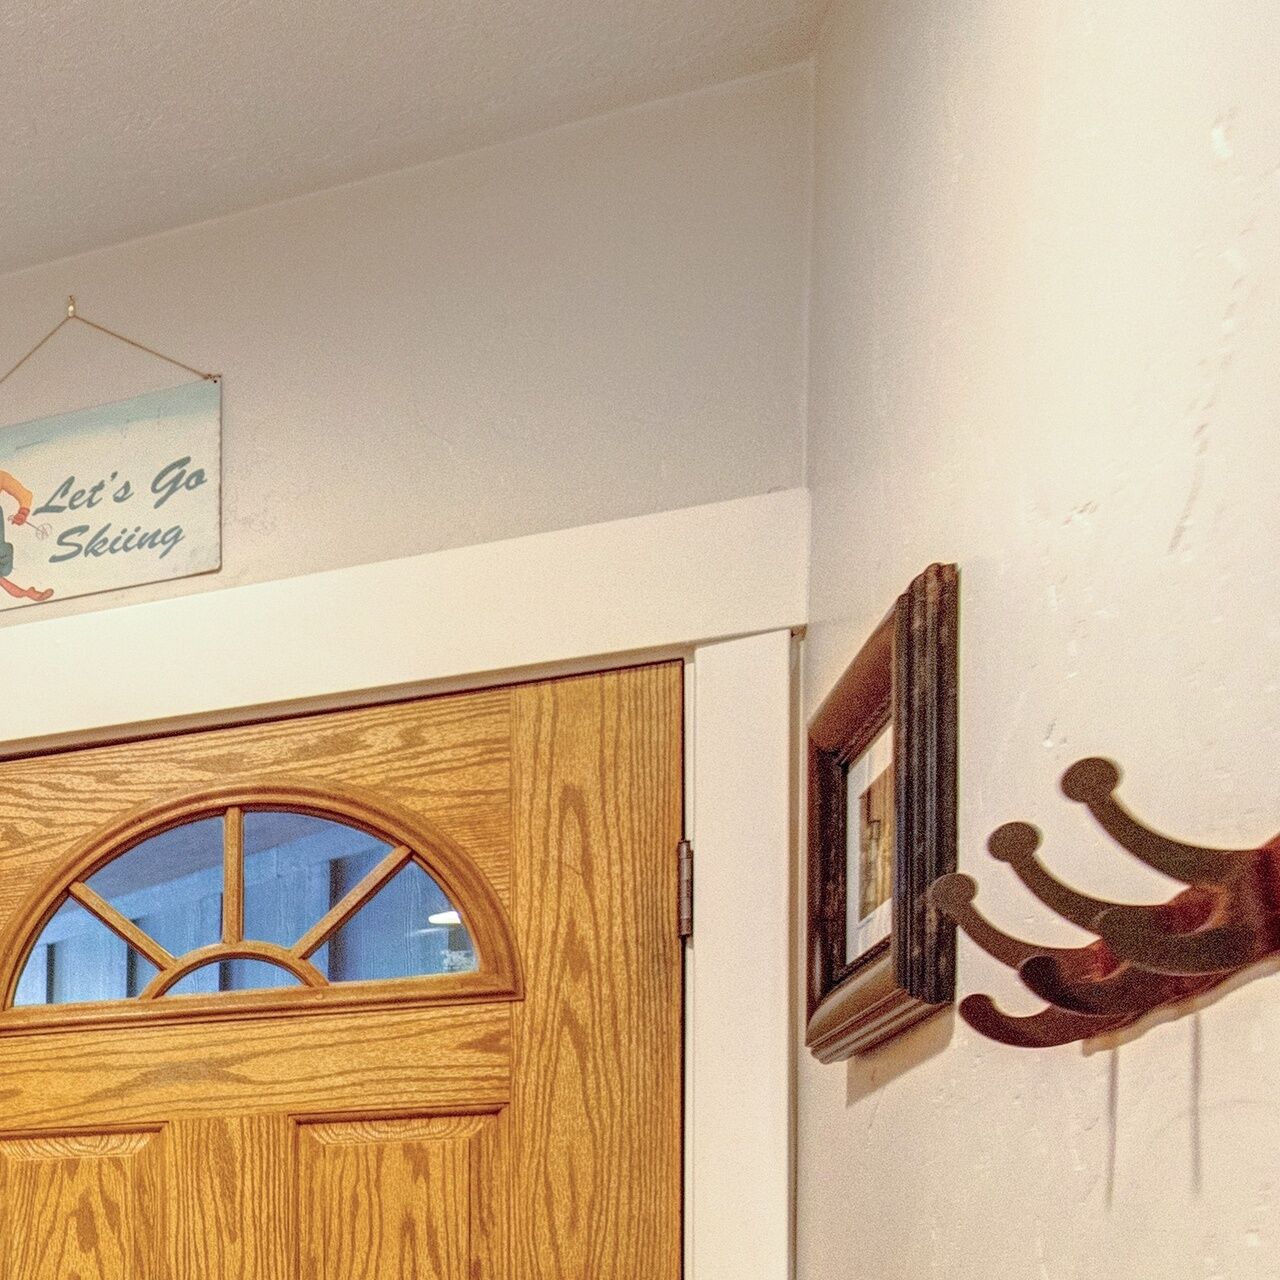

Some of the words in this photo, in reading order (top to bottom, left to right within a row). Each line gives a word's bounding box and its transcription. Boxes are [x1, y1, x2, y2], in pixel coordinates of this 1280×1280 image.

[32, 471, 134, 516] Let's
[151, 456, 207, 509] Go
[48, 522, 186, 564] Skiing
